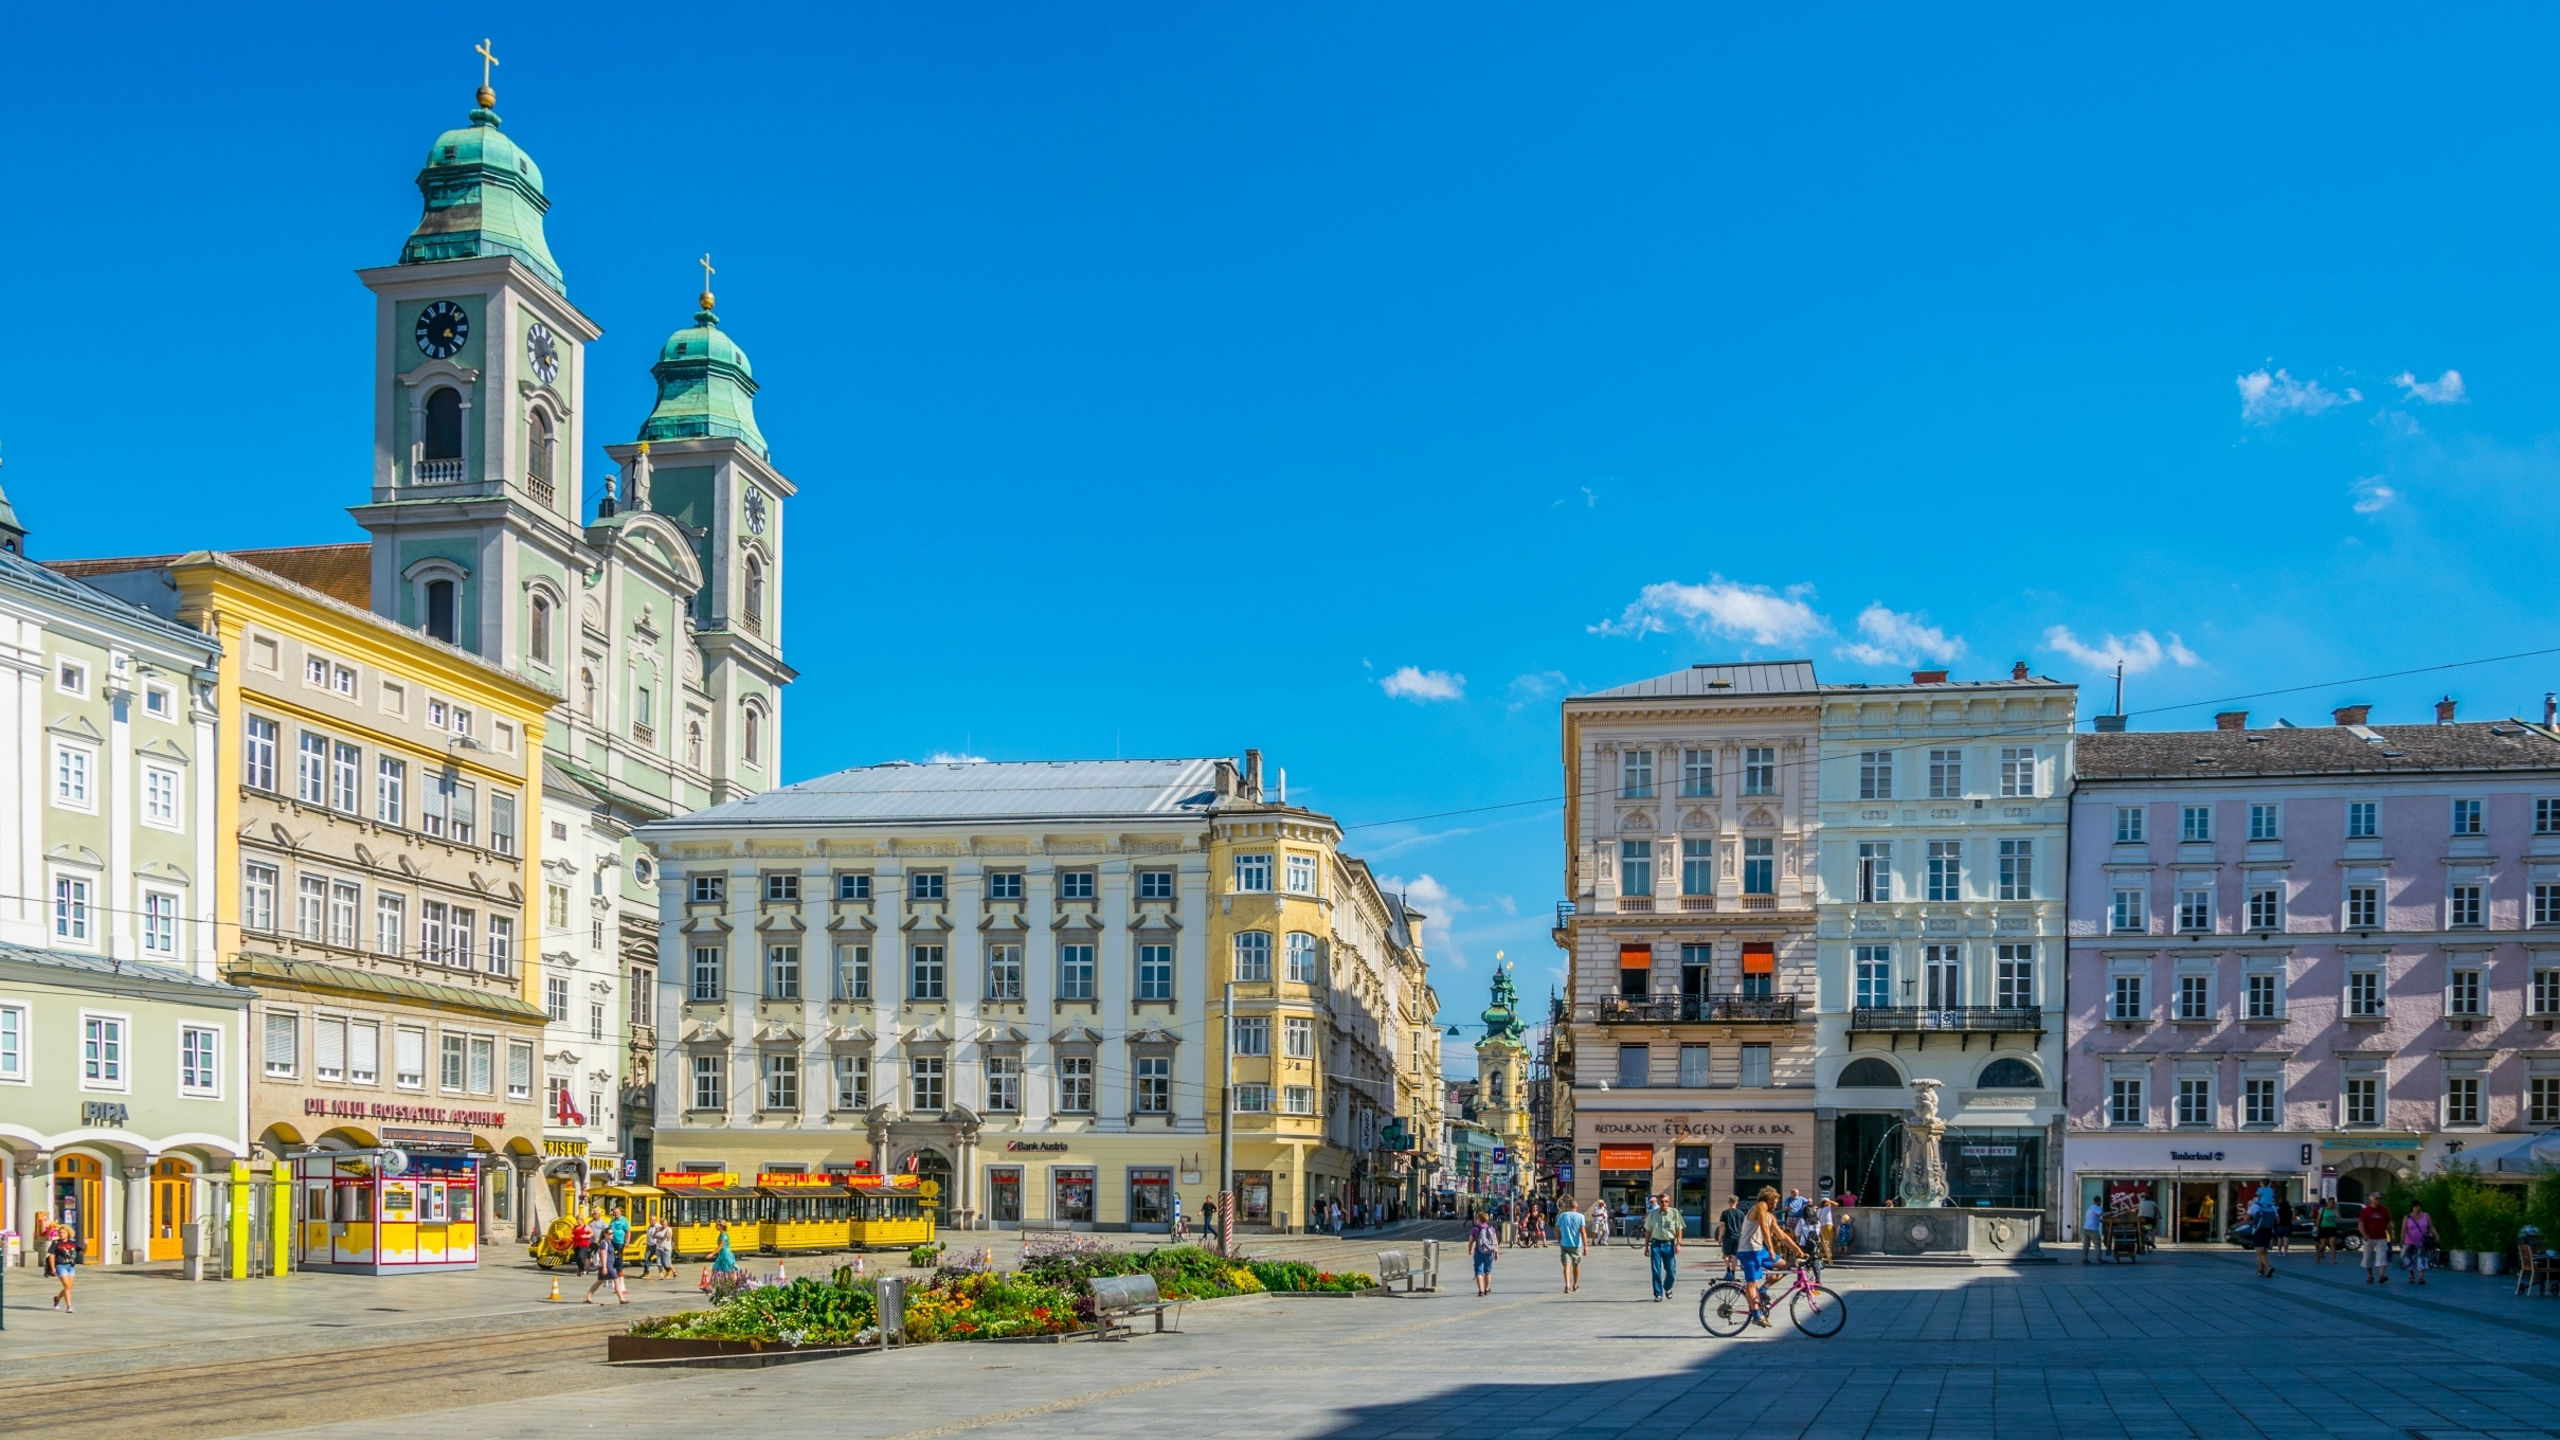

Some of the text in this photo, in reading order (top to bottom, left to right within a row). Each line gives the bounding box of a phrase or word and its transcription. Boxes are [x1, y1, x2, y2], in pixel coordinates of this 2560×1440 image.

[83, 1101, 130, 1120] BIPA
[305, 1098, 329, 1114] DIE
[333, 1100, 369, 1117] NEUE
[450, 1109, 507, 1125] APOTHEKE
[1595, 1123, 1657, 1134] RESTAURANT
[1665, 1123, 1725, 1135] ETAGEN
[1770, 1124, 1794, 1135] BAR
[1017, 1141, 1068, 1151] Bank Austria
[2170, 1152, 2213, 1161] Timberland
